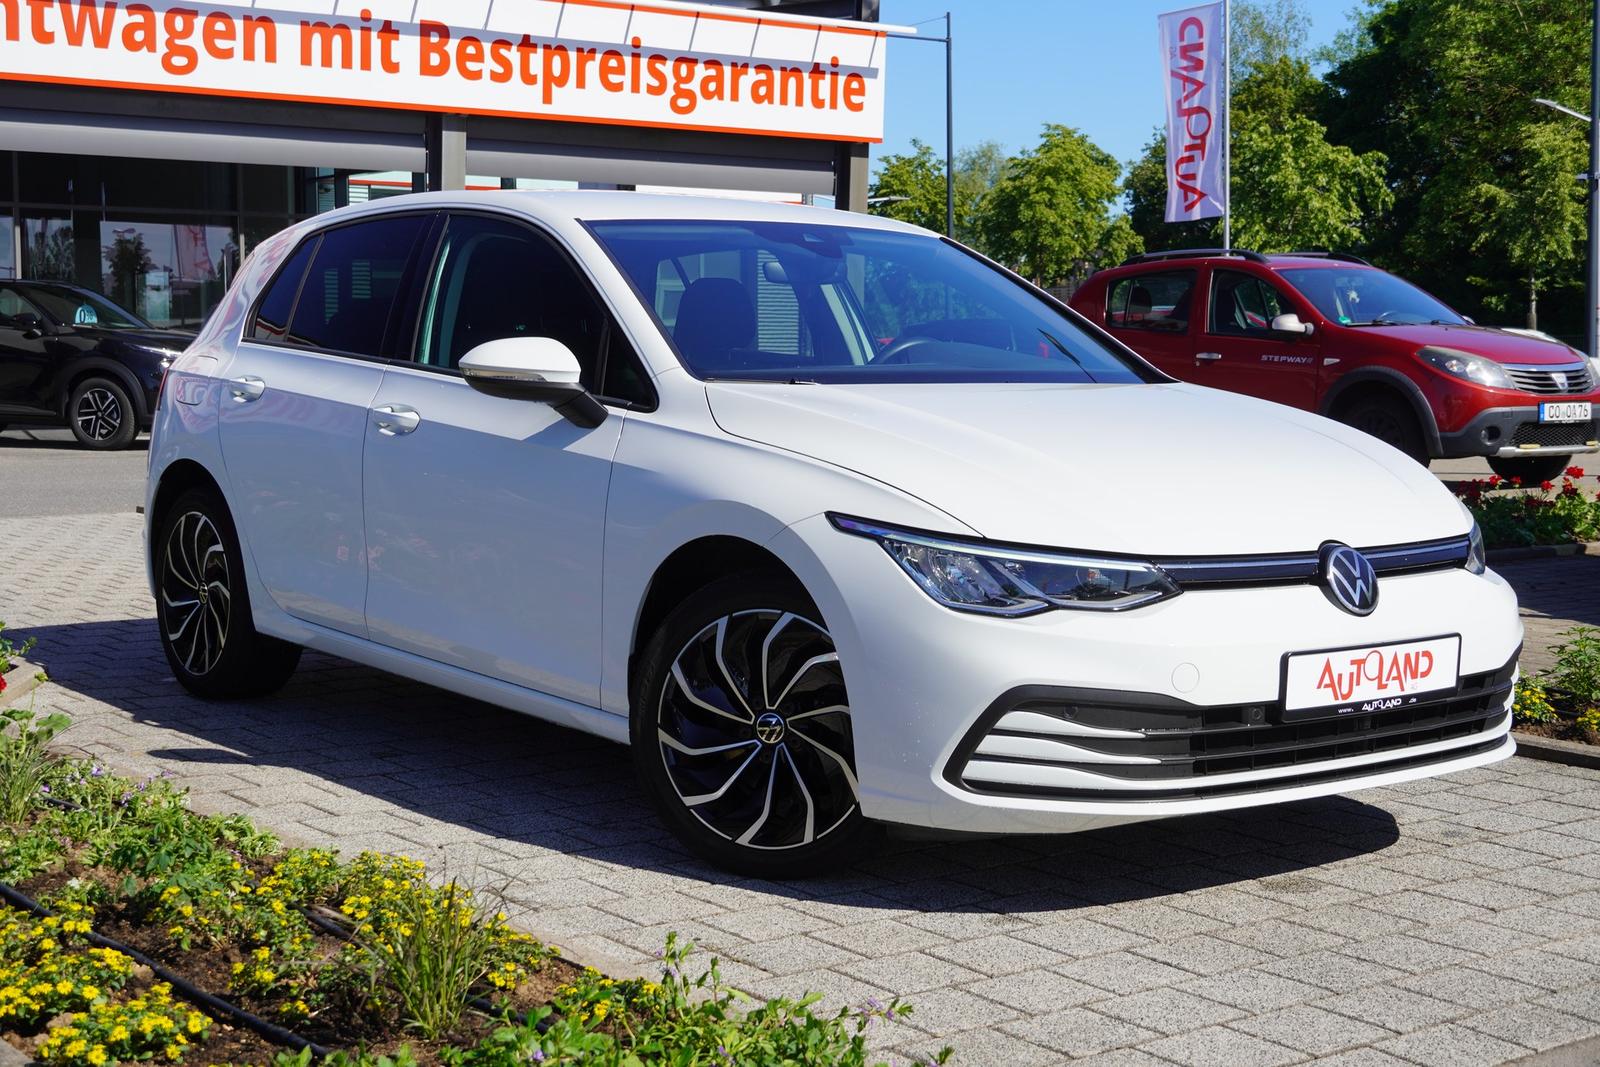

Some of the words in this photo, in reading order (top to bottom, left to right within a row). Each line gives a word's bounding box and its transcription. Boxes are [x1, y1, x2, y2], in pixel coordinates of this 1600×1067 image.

[300, 9, 400, 74] mit
[420, 19, 866, 115] Bestpreisgarantie
[1261, 355, 1307, 363] STEPWAY
